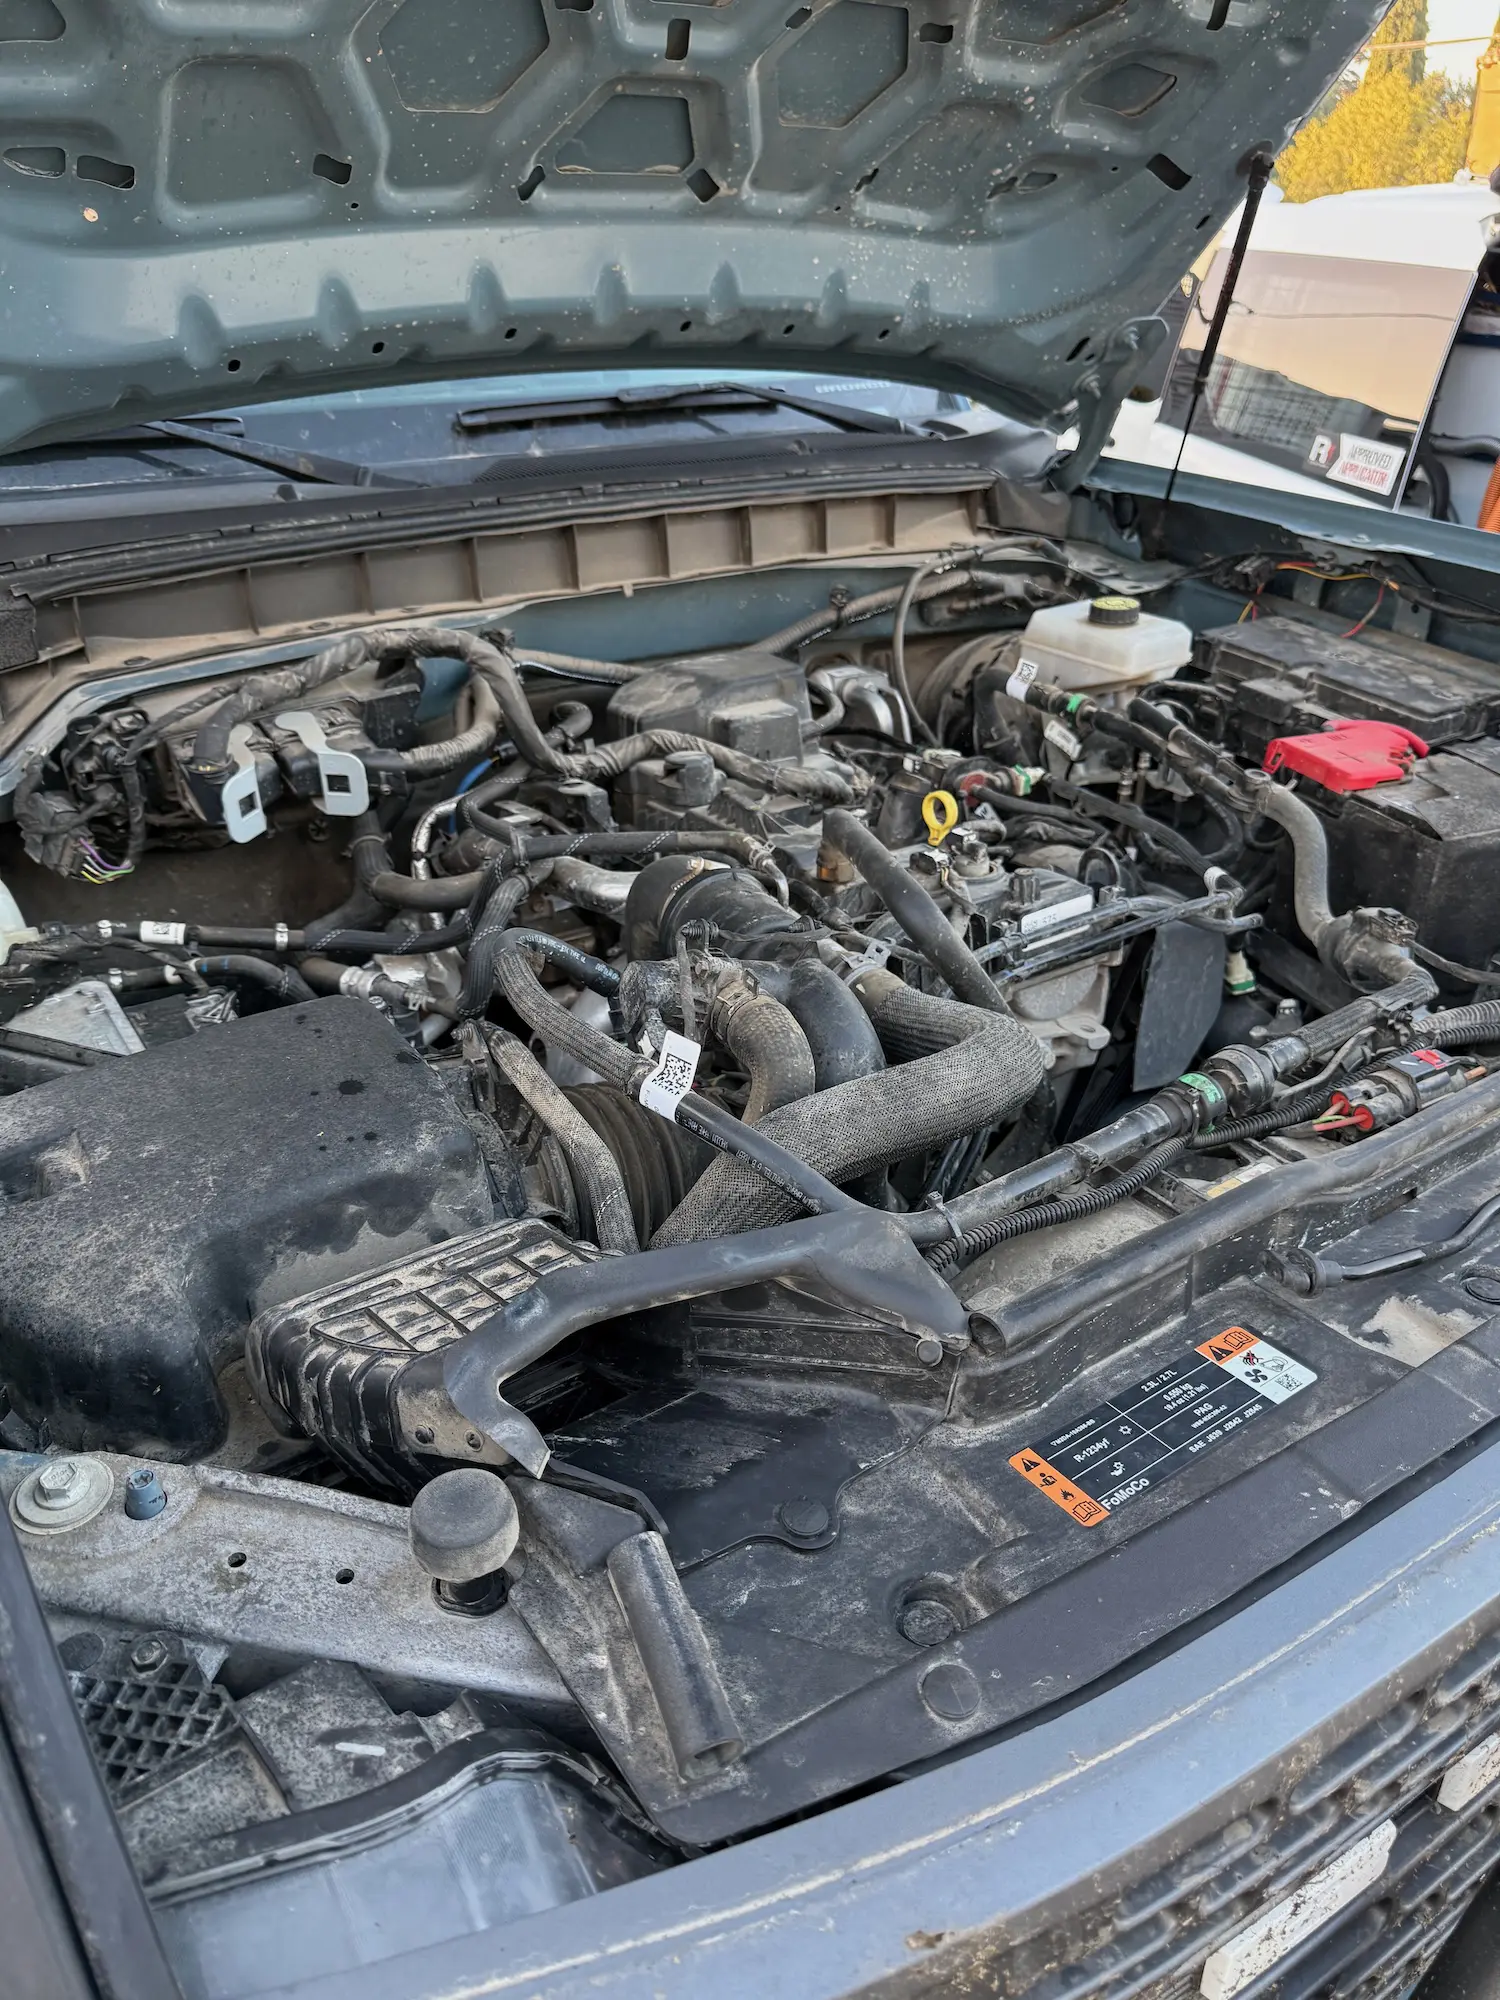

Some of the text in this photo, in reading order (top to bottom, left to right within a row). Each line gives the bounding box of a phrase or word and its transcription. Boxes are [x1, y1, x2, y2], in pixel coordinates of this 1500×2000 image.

[1141, 1380, 1160, 1392] 2.3L
[1160, 1369, 1177, 1381] 2.7L
[1163, 1382, 1194, 1401] 0.550 kg
[1193, 1402, 1213, 1416] PAG
[1073, 1437, 1110, 1463] R-1234yf
[1188, 1440, 1206, 1453] SAE
[1206, 1429, 1223, 1442] J639
[1101, 1477, 1150, 1510] FoMoCo
